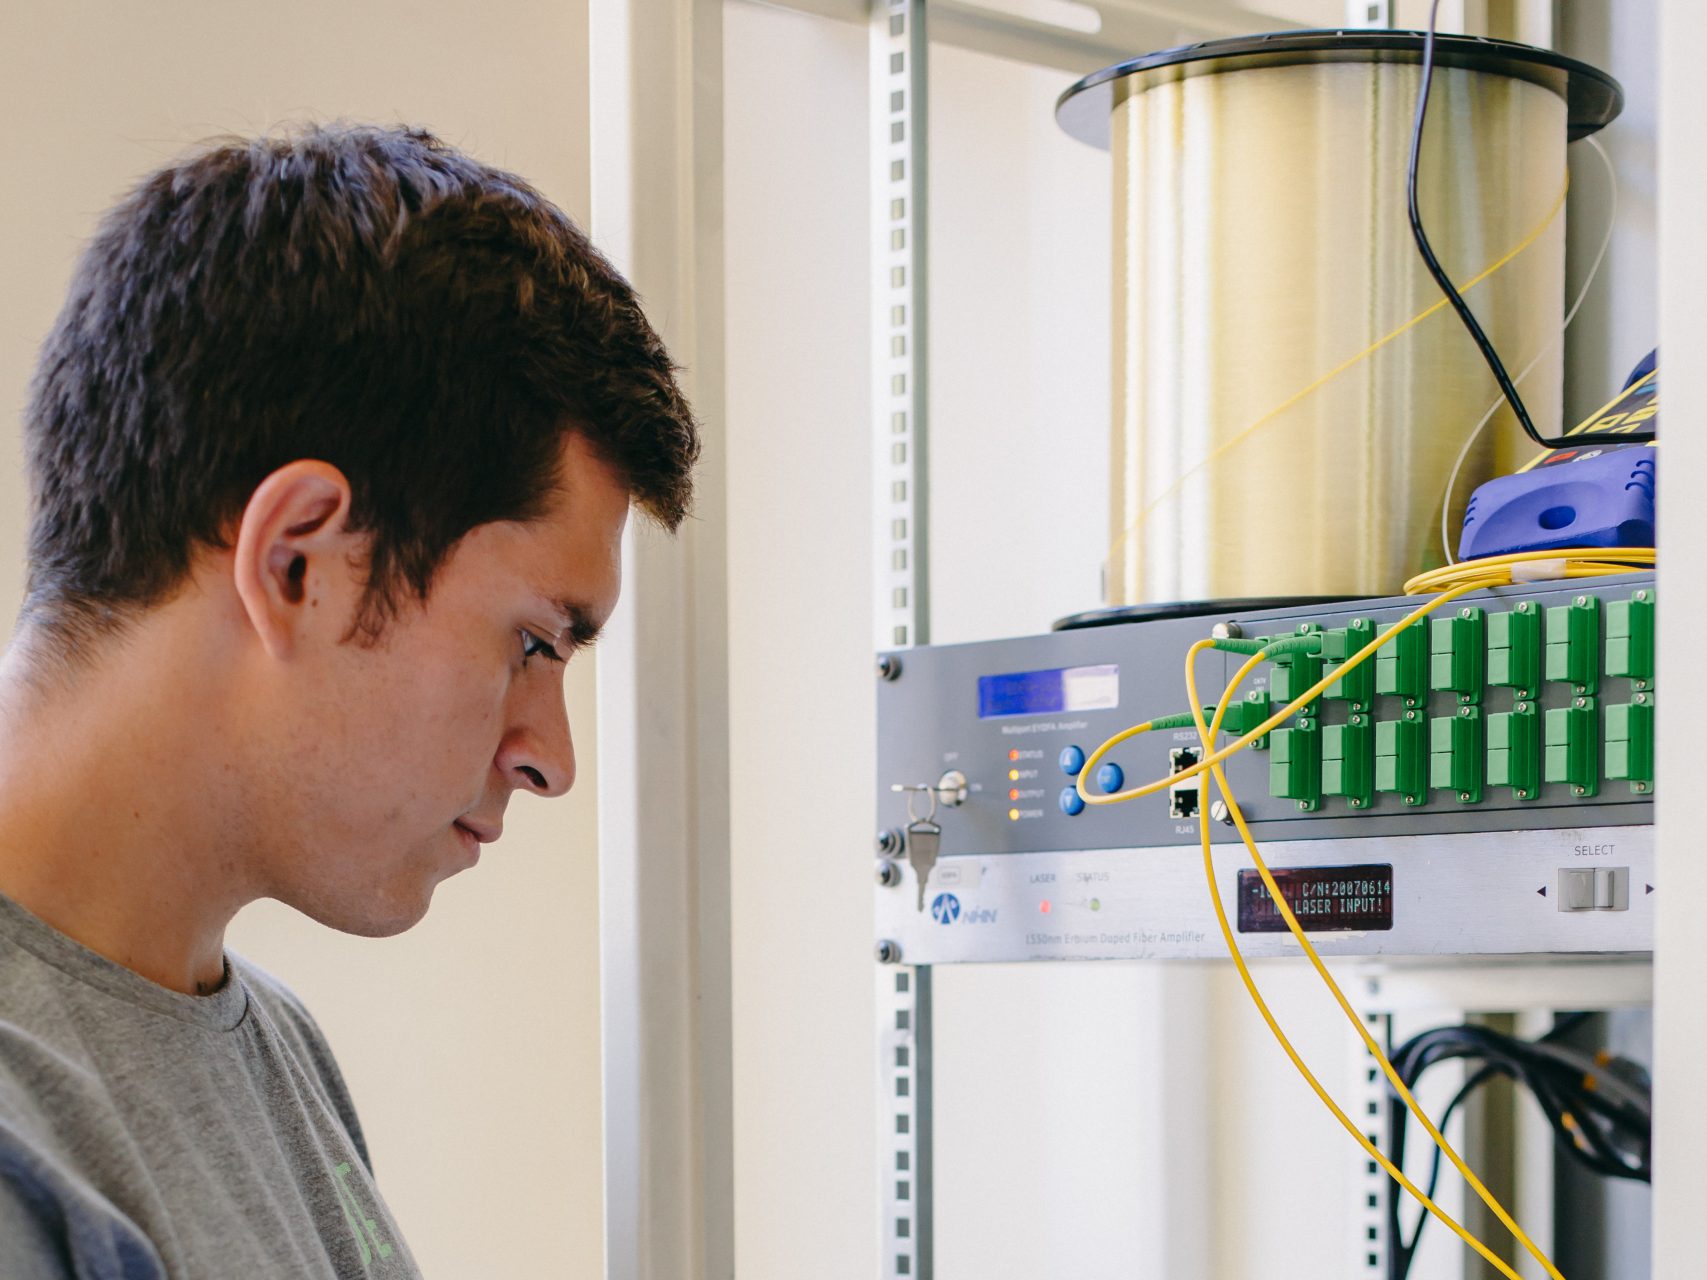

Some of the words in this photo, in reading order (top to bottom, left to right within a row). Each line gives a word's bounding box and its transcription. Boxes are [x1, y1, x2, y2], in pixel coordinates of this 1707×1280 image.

[1173, 731, 1197, 741] RS232
[1175, 825, 1195, 834] RJ45
[1574, 844, 1615, 856] SELECT
[1030, 873, 1056, 884] LASER
[1295, 899, 1332, 915] LASER
[1340, 897, 1382, 914] INPUT!
[1133, 931, 1157, 943] Fiber
[1160, 930, 1205, 945] Amplifier
